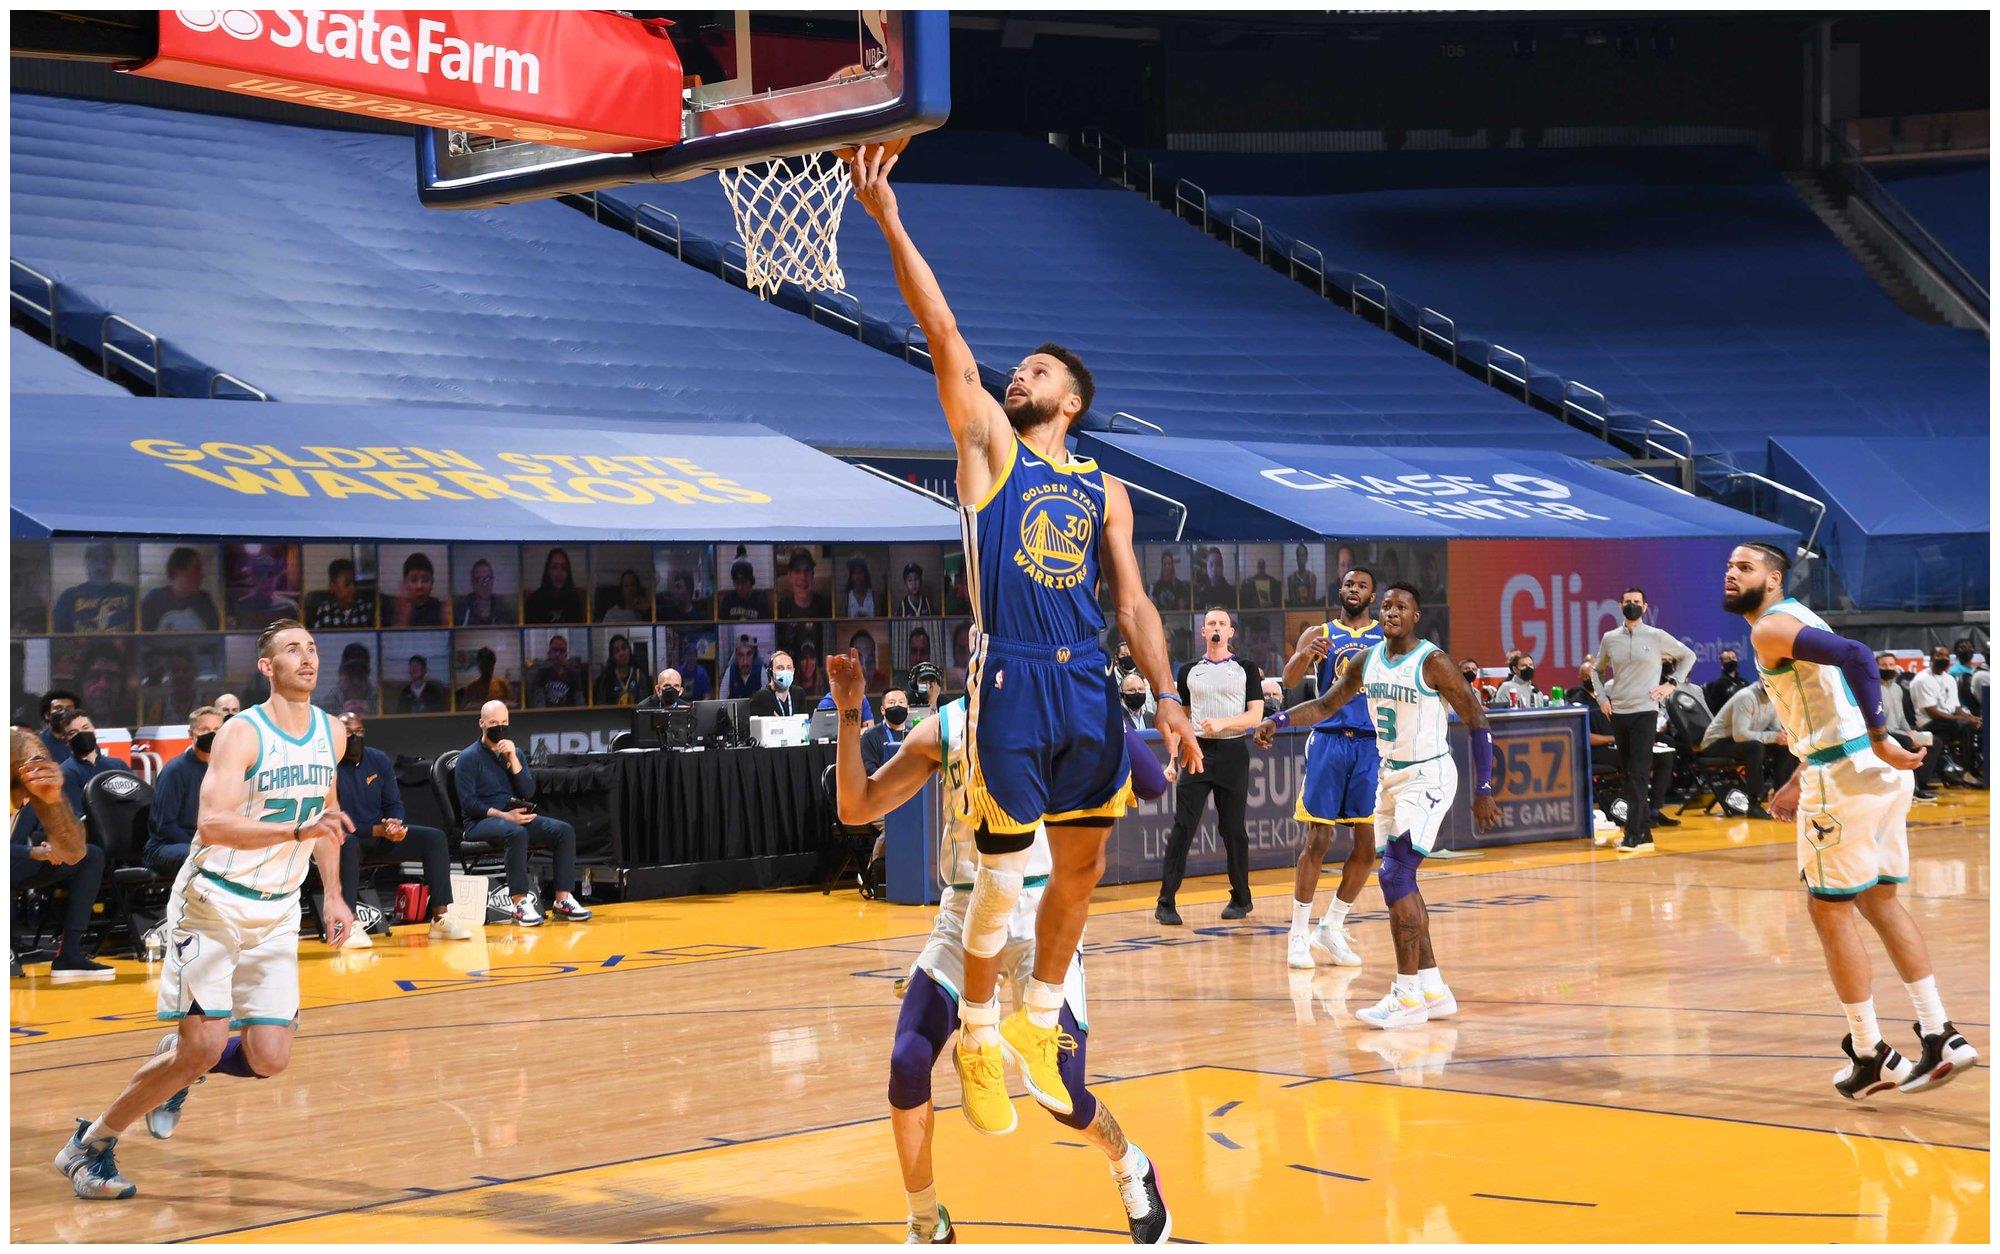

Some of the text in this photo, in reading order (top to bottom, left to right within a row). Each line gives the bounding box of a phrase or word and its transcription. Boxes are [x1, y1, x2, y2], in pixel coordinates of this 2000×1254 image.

[130, 438, 719, 476] GOLDEN STATE
[164, 463, 772, 504] WARRIORS
[1022, 484, 1067, 501] GOLDEN
[1260, 467, 1513, 496] CHASE
[1367, 497, 1611, 521] CENTER
[1063, 514, 1088, 541] 30
[1013, 549, 1087, 589] WARRIORS
[1377, 707, 1397, 742] 3
[1520, 801, 1572, 826] GAME
